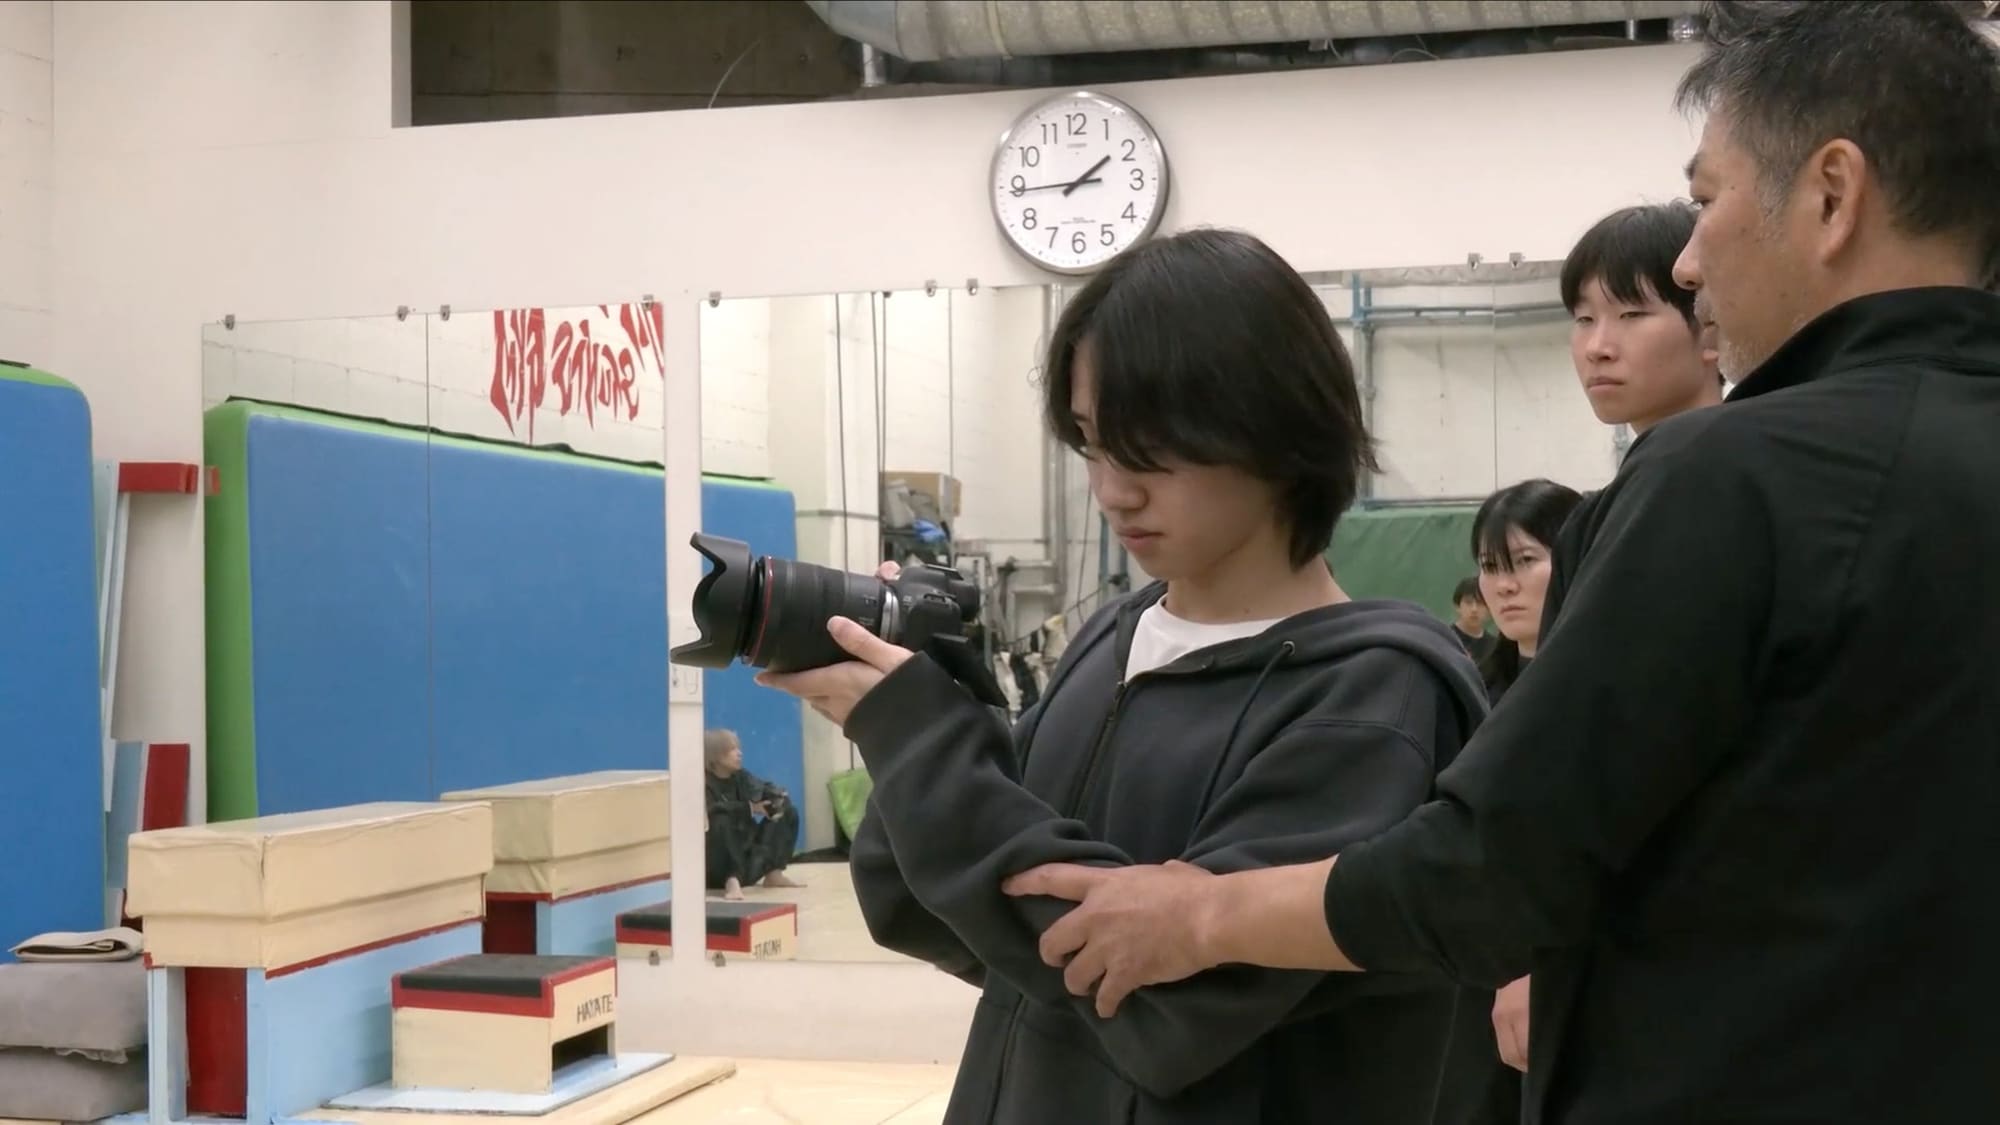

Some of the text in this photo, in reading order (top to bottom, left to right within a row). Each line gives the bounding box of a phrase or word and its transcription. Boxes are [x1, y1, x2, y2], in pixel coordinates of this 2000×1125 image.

[1041, 123, 1058, 145] 11
[1065, 113, 1087, 136] 12
[1102, 118, 1109, 141] 1
[1019, 146, 1040, 168] 10
[1121, 139, 1136, 161] 2
[1010, 175, 1026, 197] 9
[1129, 168, 1145, 191] 3
[1022, 207, 1037, 230] 8
[1121, 201, 1137, 223] 4
[1045, 227, 1059, 249] 7
[1072, 231, 1087, 254] 6
[1100, 224, 1115, 246] 5
[577, 993, 614, 1024] HAYATE
